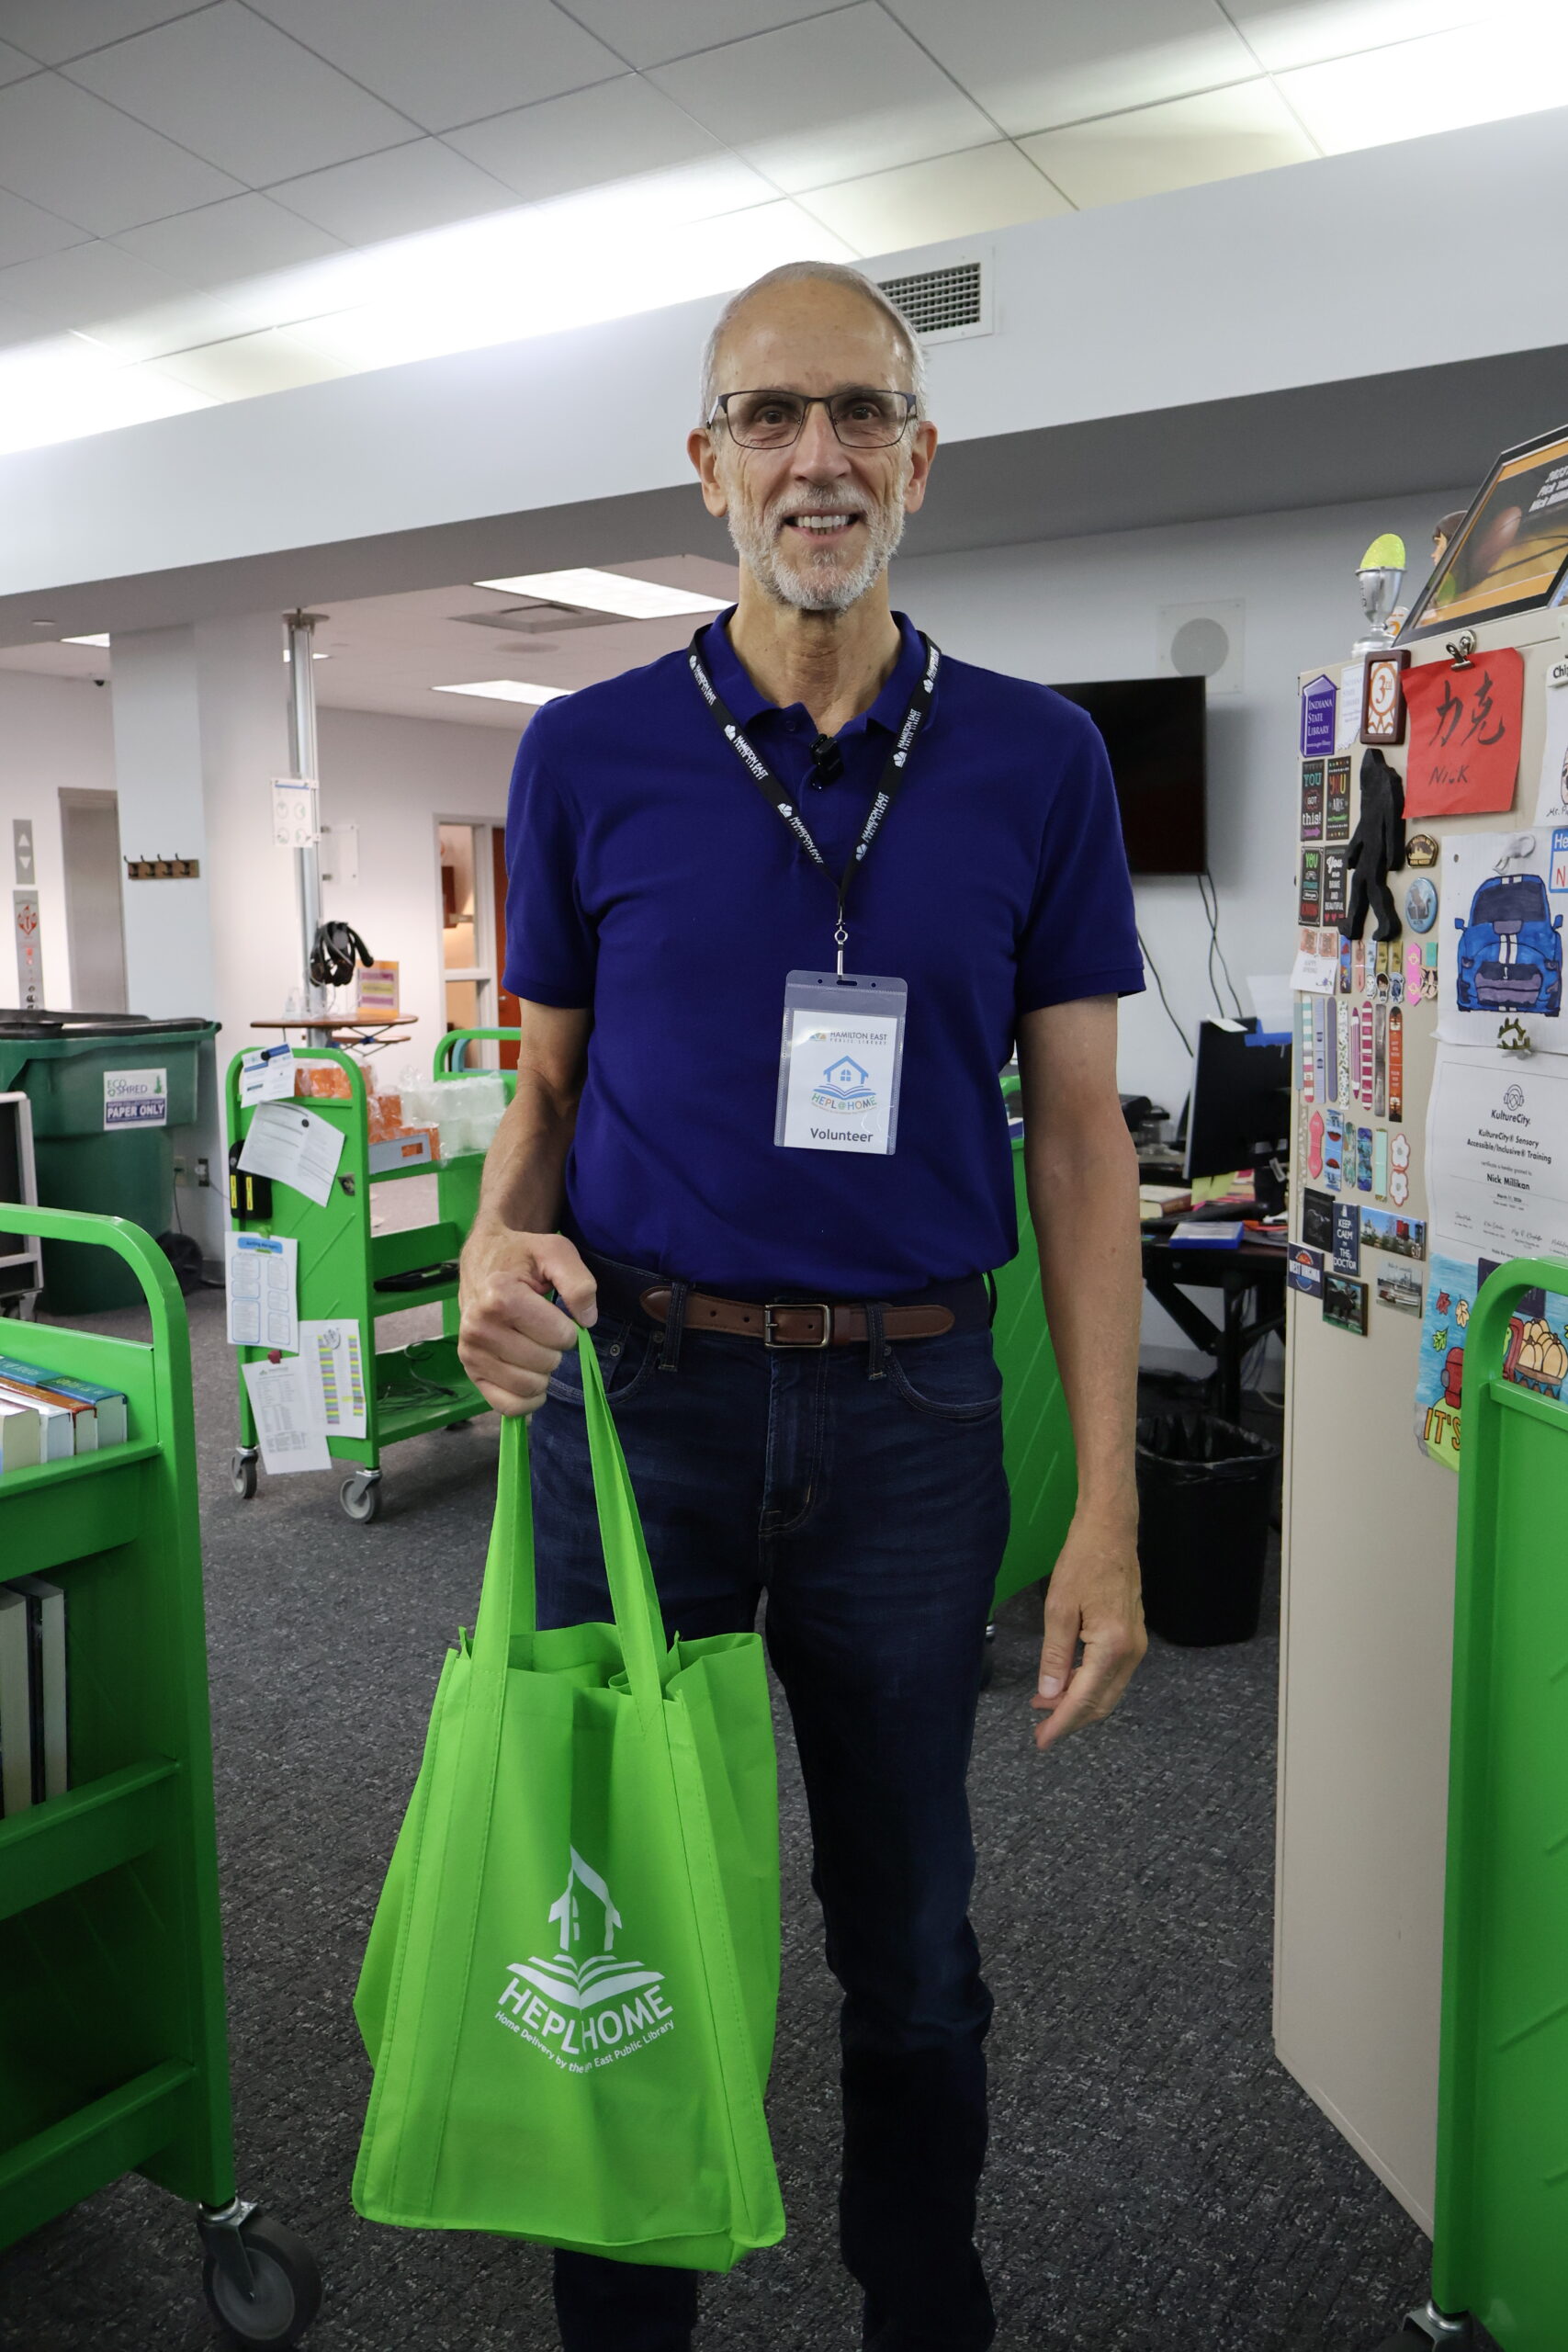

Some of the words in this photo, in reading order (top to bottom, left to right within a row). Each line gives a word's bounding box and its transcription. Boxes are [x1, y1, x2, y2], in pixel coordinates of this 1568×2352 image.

[1553, 664, 1568, 679] Chi
[1308, 699, 1333, 710] INDIANA
[1308, 713, 1324, 724] STATE
[1308, 726, 1329, 736] LIBRARY
[1303, 773, 1322, 786] YOU
[1329, 774, 1346, 795] YOU
[1307, 796, 1318, 805] GOT
[1332, 797, 1344, 812] ARE
[1302, 811, 1321, 825] this!
[1305, 853, 1318, 868] YOU
[1326, 855, 1343, 874] You
[107, 1105, 137, 1118] PAPER
[140, 1103, 164, 1115] ONLY
[1491, 1110, 1530, 1127] KultureCity
[810, 1127, 874, 1142] Volunteer
[1516, 1136, 1539, 1148] Sensory
[1528, 1150, 1551, 1164] Training
[1486, 1173, 1502, 1184] Nick
[1504, 1177, 1530, 1191] Millikan
[1337, 1218, 1351, 1228] KEEP
[1337, 1228, 1353, 1240] CALM
[1339, 1248, 1350, 1259] THE
[1333, 1257, 1357, 1271] DOCTOR
[1424, 1407, 1461, 1451] IT'S
[498, 1977, 580, 2054] HEPL
[581, 1984, 673, 2052] HOME
[495, 2010, 520, 2033] Home
[521, 2029, 555, 2060] Delivery
[555, 2055, 567, 2069] by
[569, 2063, 583, 2074] the
[594, 2053, 614, 2067] East
[615, 2041, 642, 2059] Public
[642, 2019, 674, 2044] Library
